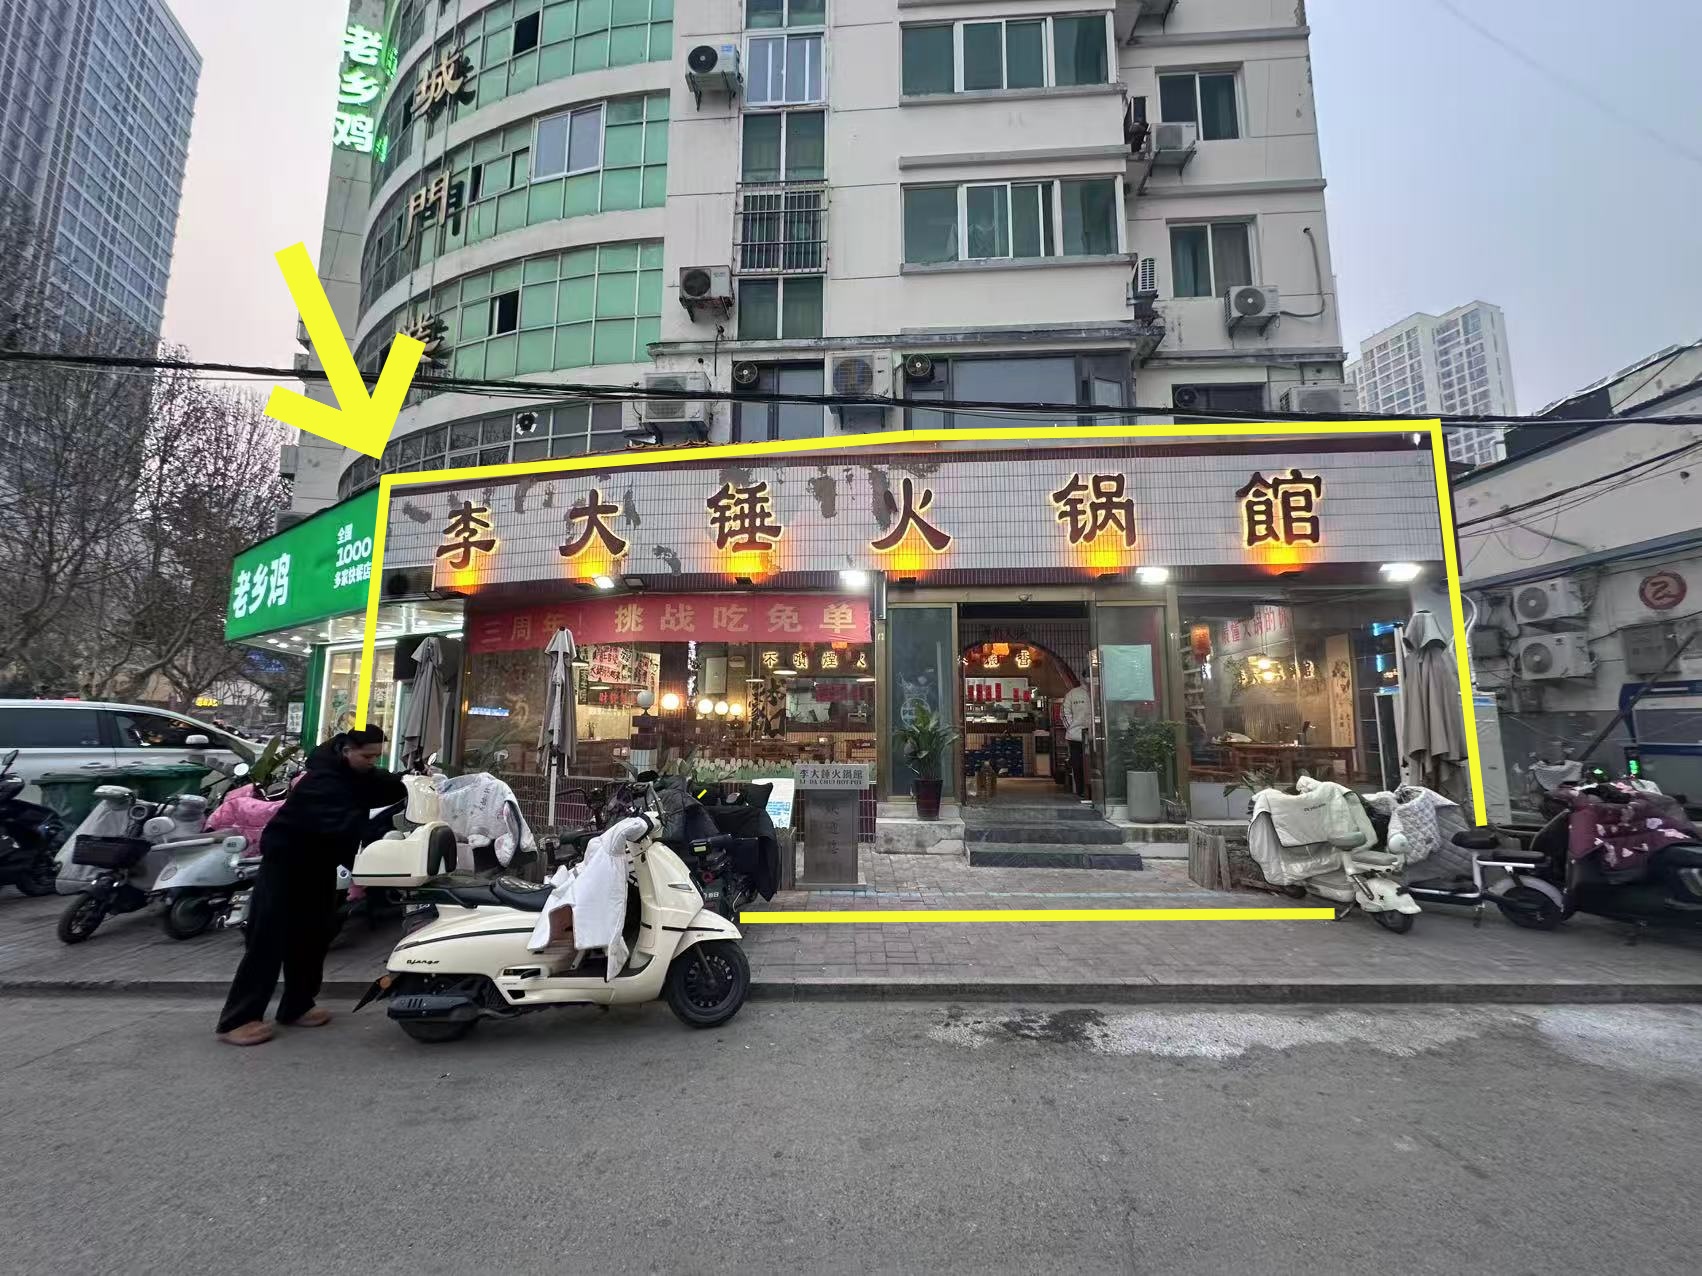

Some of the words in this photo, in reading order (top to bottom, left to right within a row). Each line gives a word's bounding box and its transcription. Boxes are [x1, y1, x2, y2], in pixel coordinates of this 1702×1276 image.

[332, 24, 382, 153] 老乡鸡
[336, 523, 353, 545] 全国
[436, 468, 1322, 570] 李大锤火锅館
[336, 537, 372, 567] 1000
[233, 552, 290, 618] 老乡鸡
[333, 561, 372, 589] 多家快餐店
[614, 603, 856, 634] 挑战吃免单
